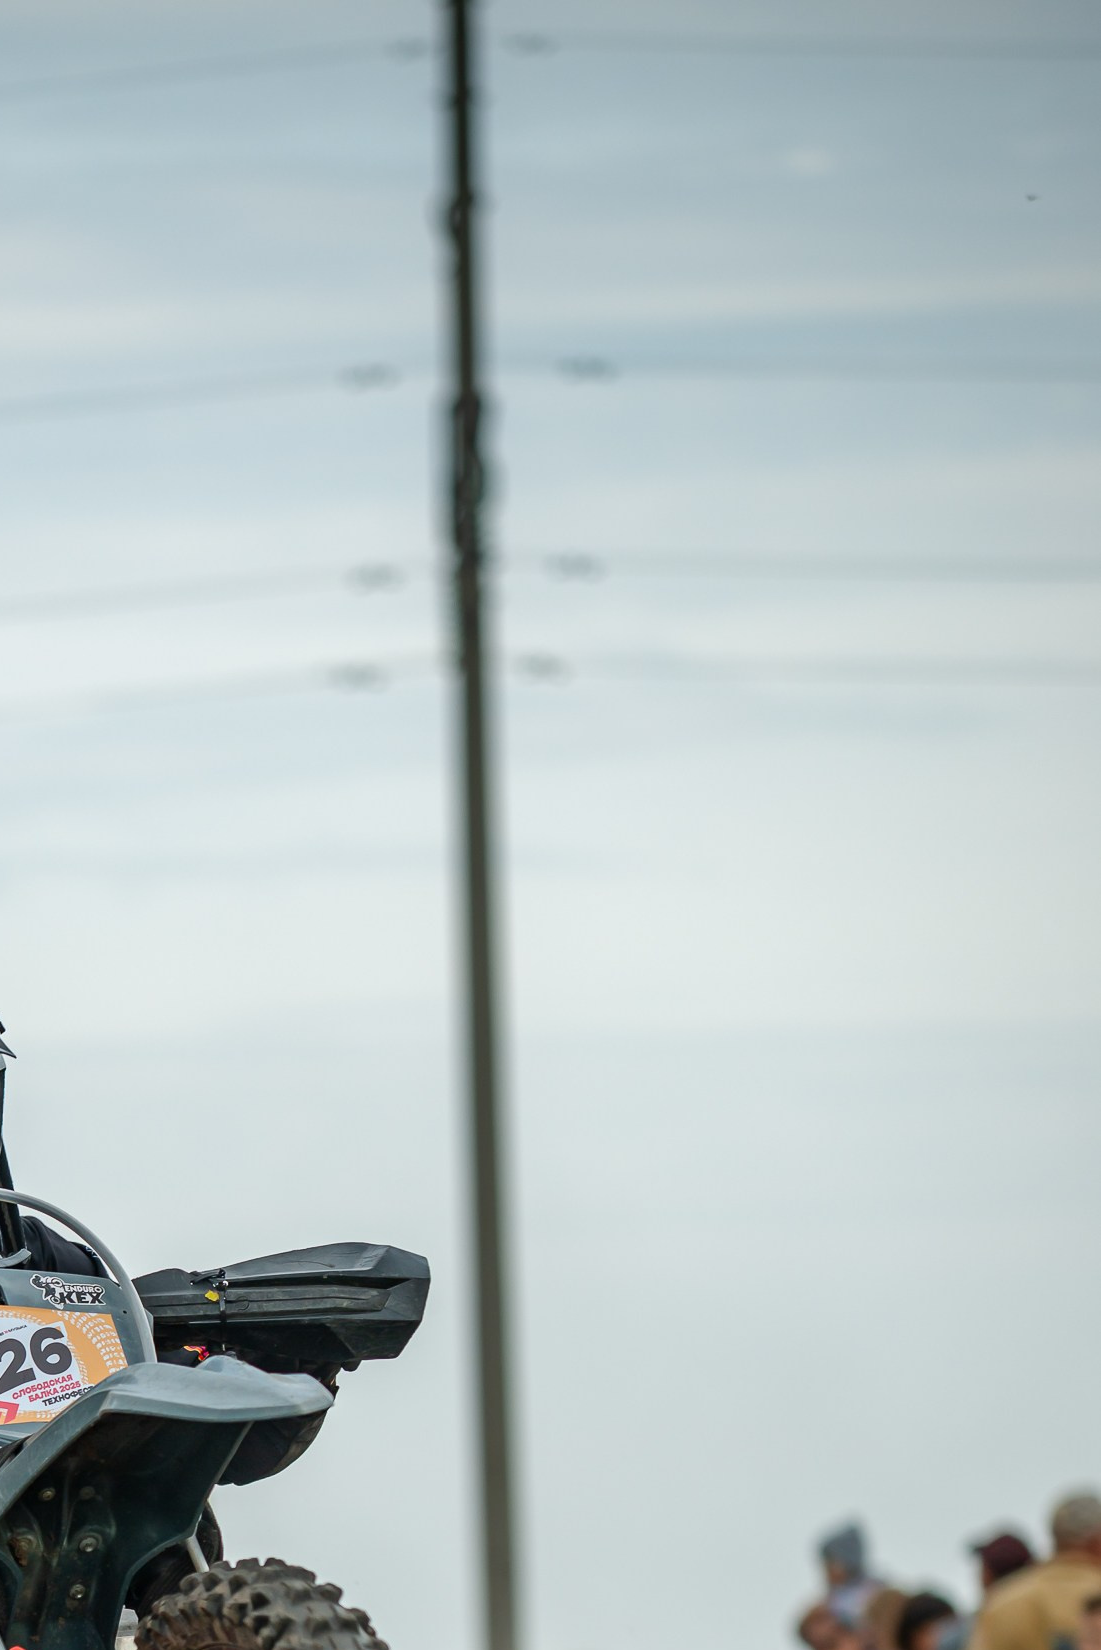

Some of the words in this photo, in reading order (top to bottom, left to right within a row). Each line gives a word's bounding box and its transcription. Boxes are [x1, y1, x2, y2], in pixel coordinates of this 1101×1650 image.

[64, 1285, 103, 1293] ENDURO
[11, 1374, 74, 1401] СЛОБОДСКАЯ
[28, 1387, 59, 1403] БАЛКА
[59, 1381, 82, 1394] 2025
